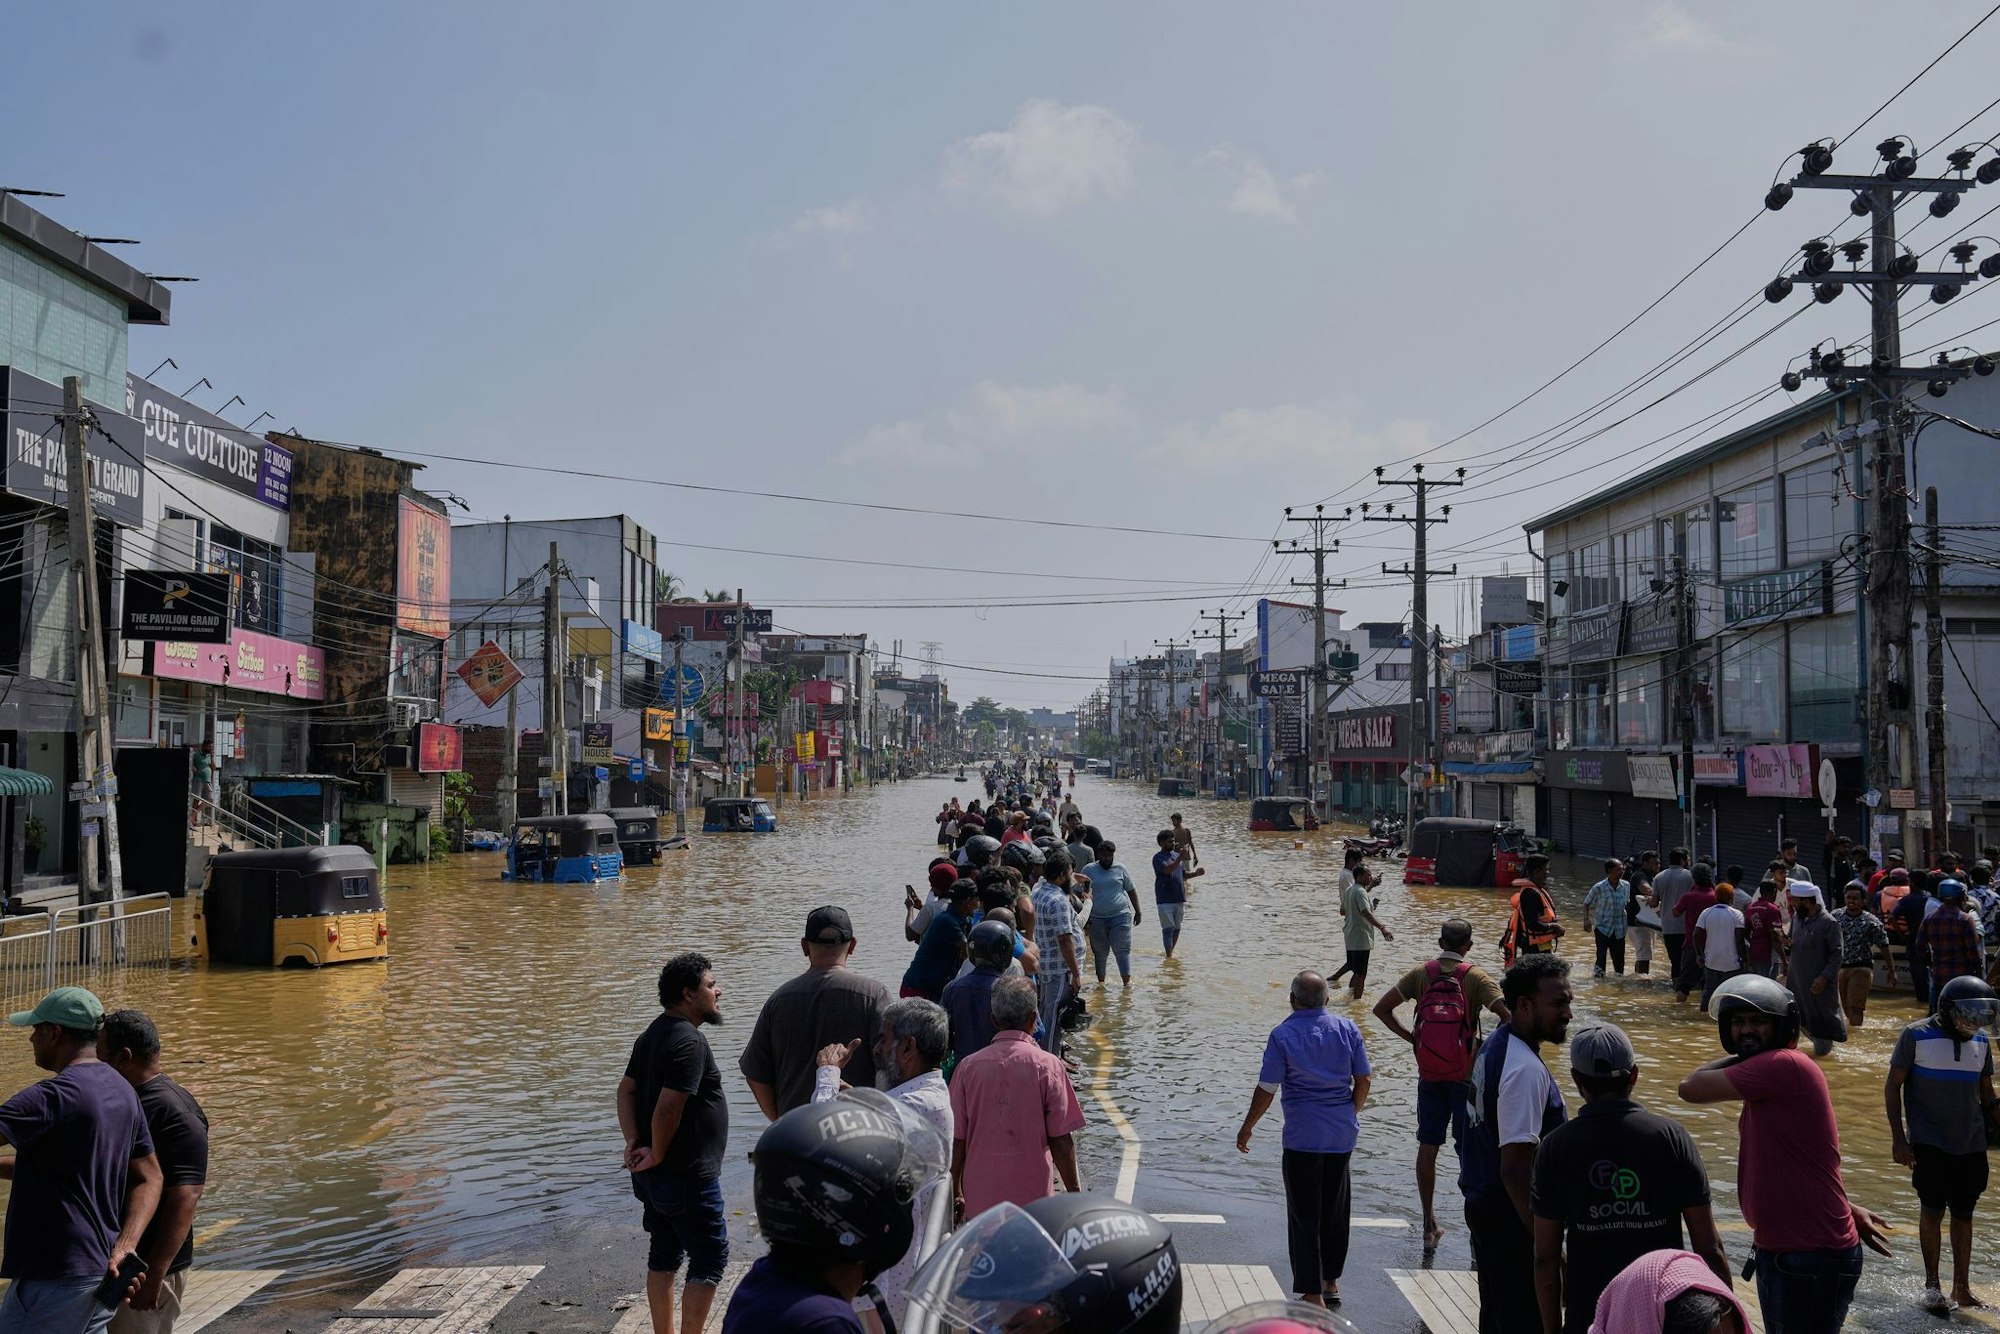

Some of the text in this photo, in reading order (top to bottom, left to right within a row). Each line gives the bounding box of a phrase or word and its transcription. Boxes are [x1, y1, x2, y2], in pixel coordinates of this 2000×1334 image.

[142, 399, 259, 483] CUE CULTURE
[16, 428, 42, 468] THE
[103, 459, 139, 498] GRAND
[272, 451, 291, 473] NOON
[1731, 568, 1815, 620] MADAME
[131, 613, 220, 626] THE PAVILION GRAND
[1259, 673, 1297, 682] MEGA
[1260, 685, 1295, 695] SALE
[1338, 718, 1363, 749] MEGA
[1365, 716, 1392, 748] SALE
[584, 748, 612, 758] HOUSE
[1751, 758, 1803, 784] Glow Up
[1619, 1175, 1634, 1194] P
[1589, 1201, 1651, 1220] SOCIAL
[1586, 1221, 1624, 1232] SOCIALIZE
[1625, 1221, 1642, 1229] YOUR
[1060, 1215, 1149, 1259] ACTION
